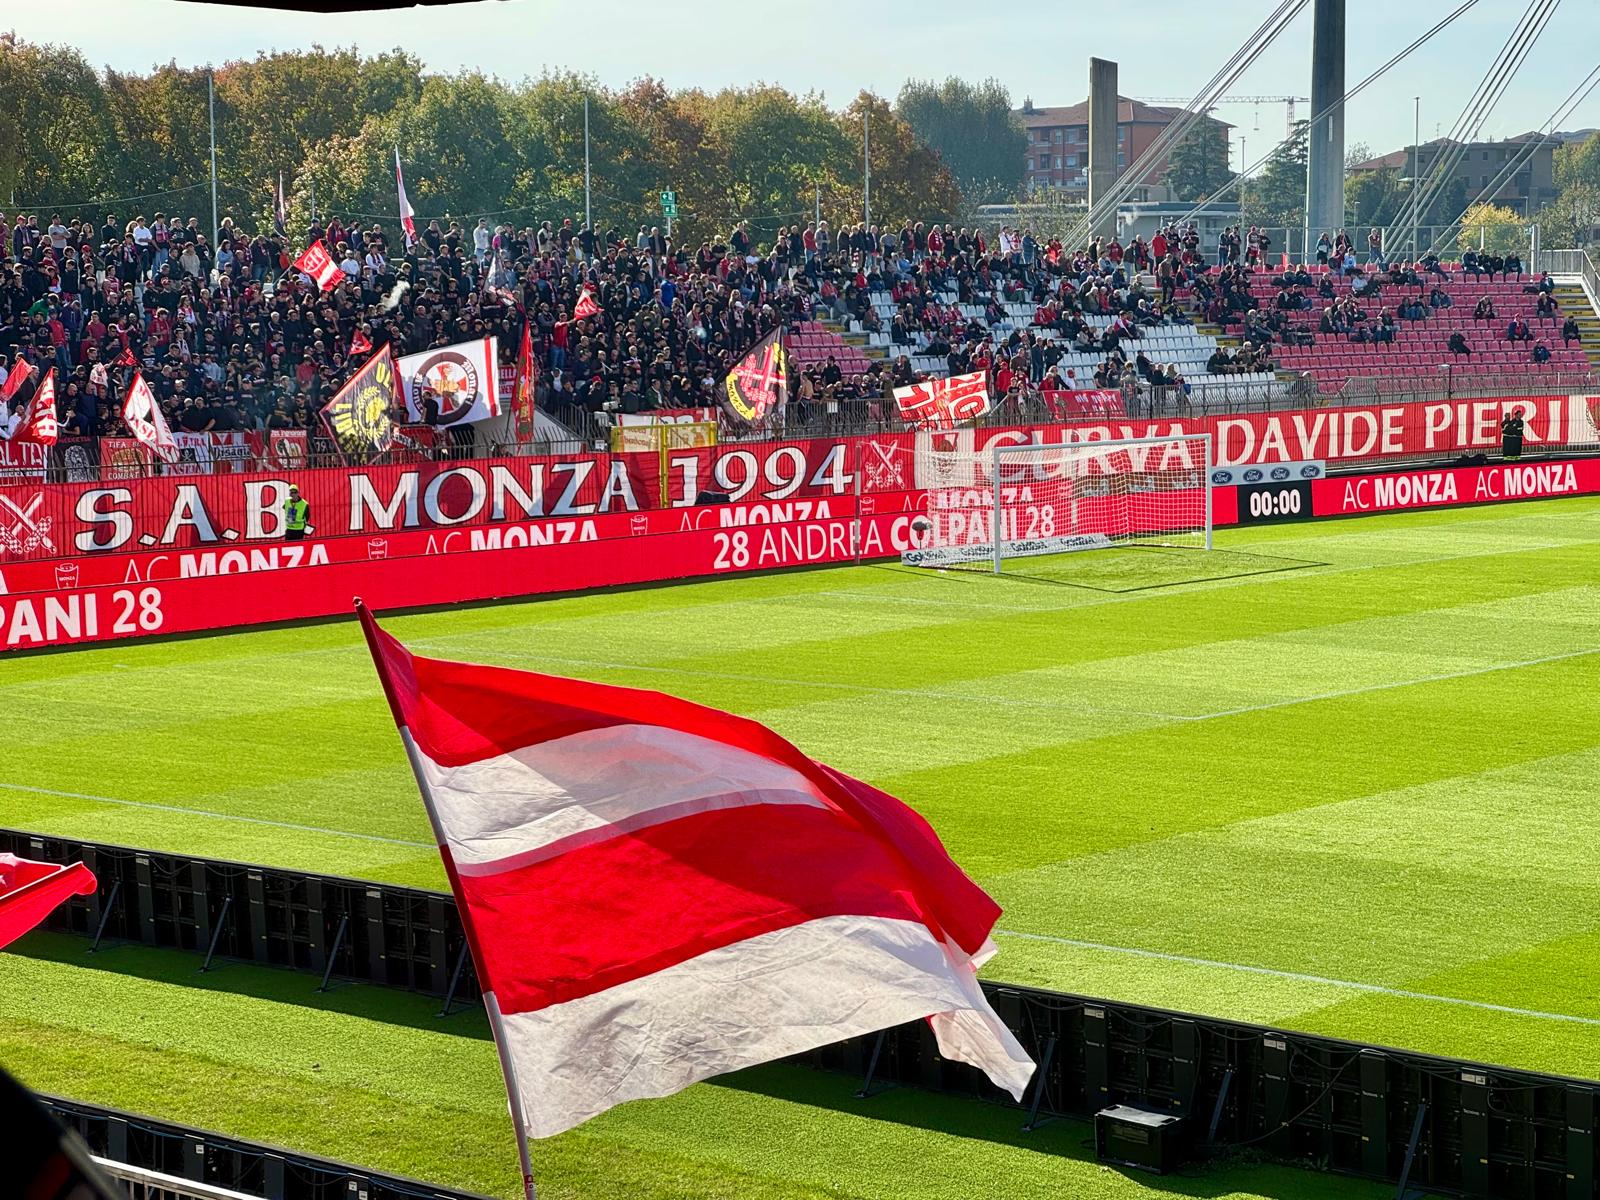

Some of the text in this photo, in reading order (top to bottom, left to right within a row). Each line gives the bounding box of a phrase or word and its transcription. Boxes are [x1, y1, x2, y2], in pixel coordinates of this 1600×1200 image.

[979, 423, 1197, 483] CURVA
[1215, 407, 1405, 466] DAVIDE
[1424, 399, 1562, 448] PIERI
[75, 444, 853, 551] S.A.B. MONZA 1994
[1342, 473, 1458, 510] AC MONZA
[1475, 464, 1578, 498] AC MONZA
[720, 500, 831, 527] MONZA
[1250, 489, 1301, 517] 00:00
[470, 520, 598, 550] MONZA
[713, 504, 1055, 569] 28 ANDREA COLPANI 28
[180, 544, 330, 578] MONZA
[0, 587, 164, 645] ANI 28
